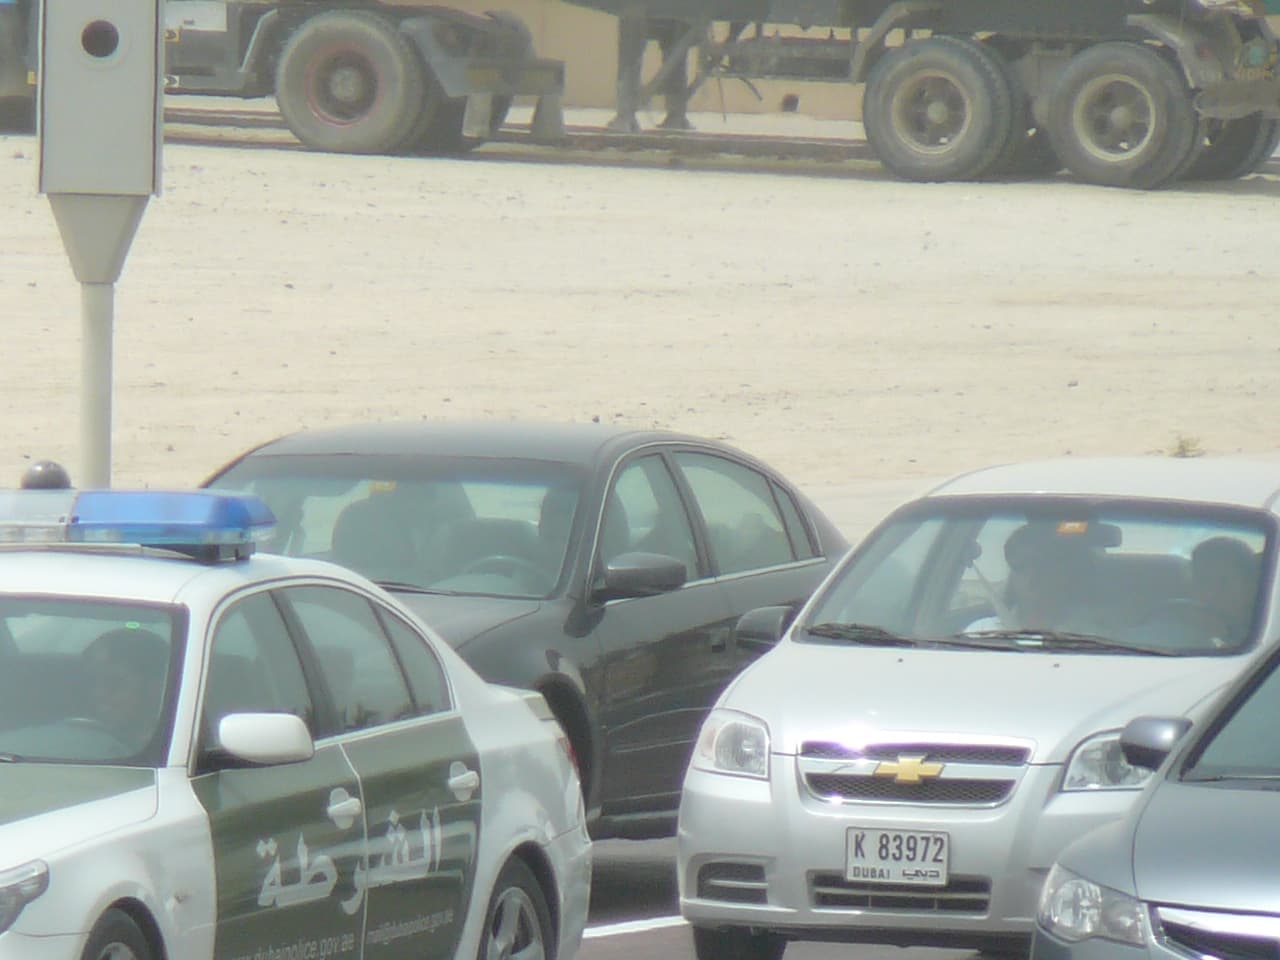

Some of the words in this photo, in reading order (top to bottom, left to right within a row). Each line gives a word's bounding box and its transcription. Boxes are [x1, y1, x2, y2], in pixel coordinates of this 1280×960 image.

[854, 832, 865, 858] K
[878, 833, 945, 863] 83972
[853, 866, 890, 879] DUBAI
